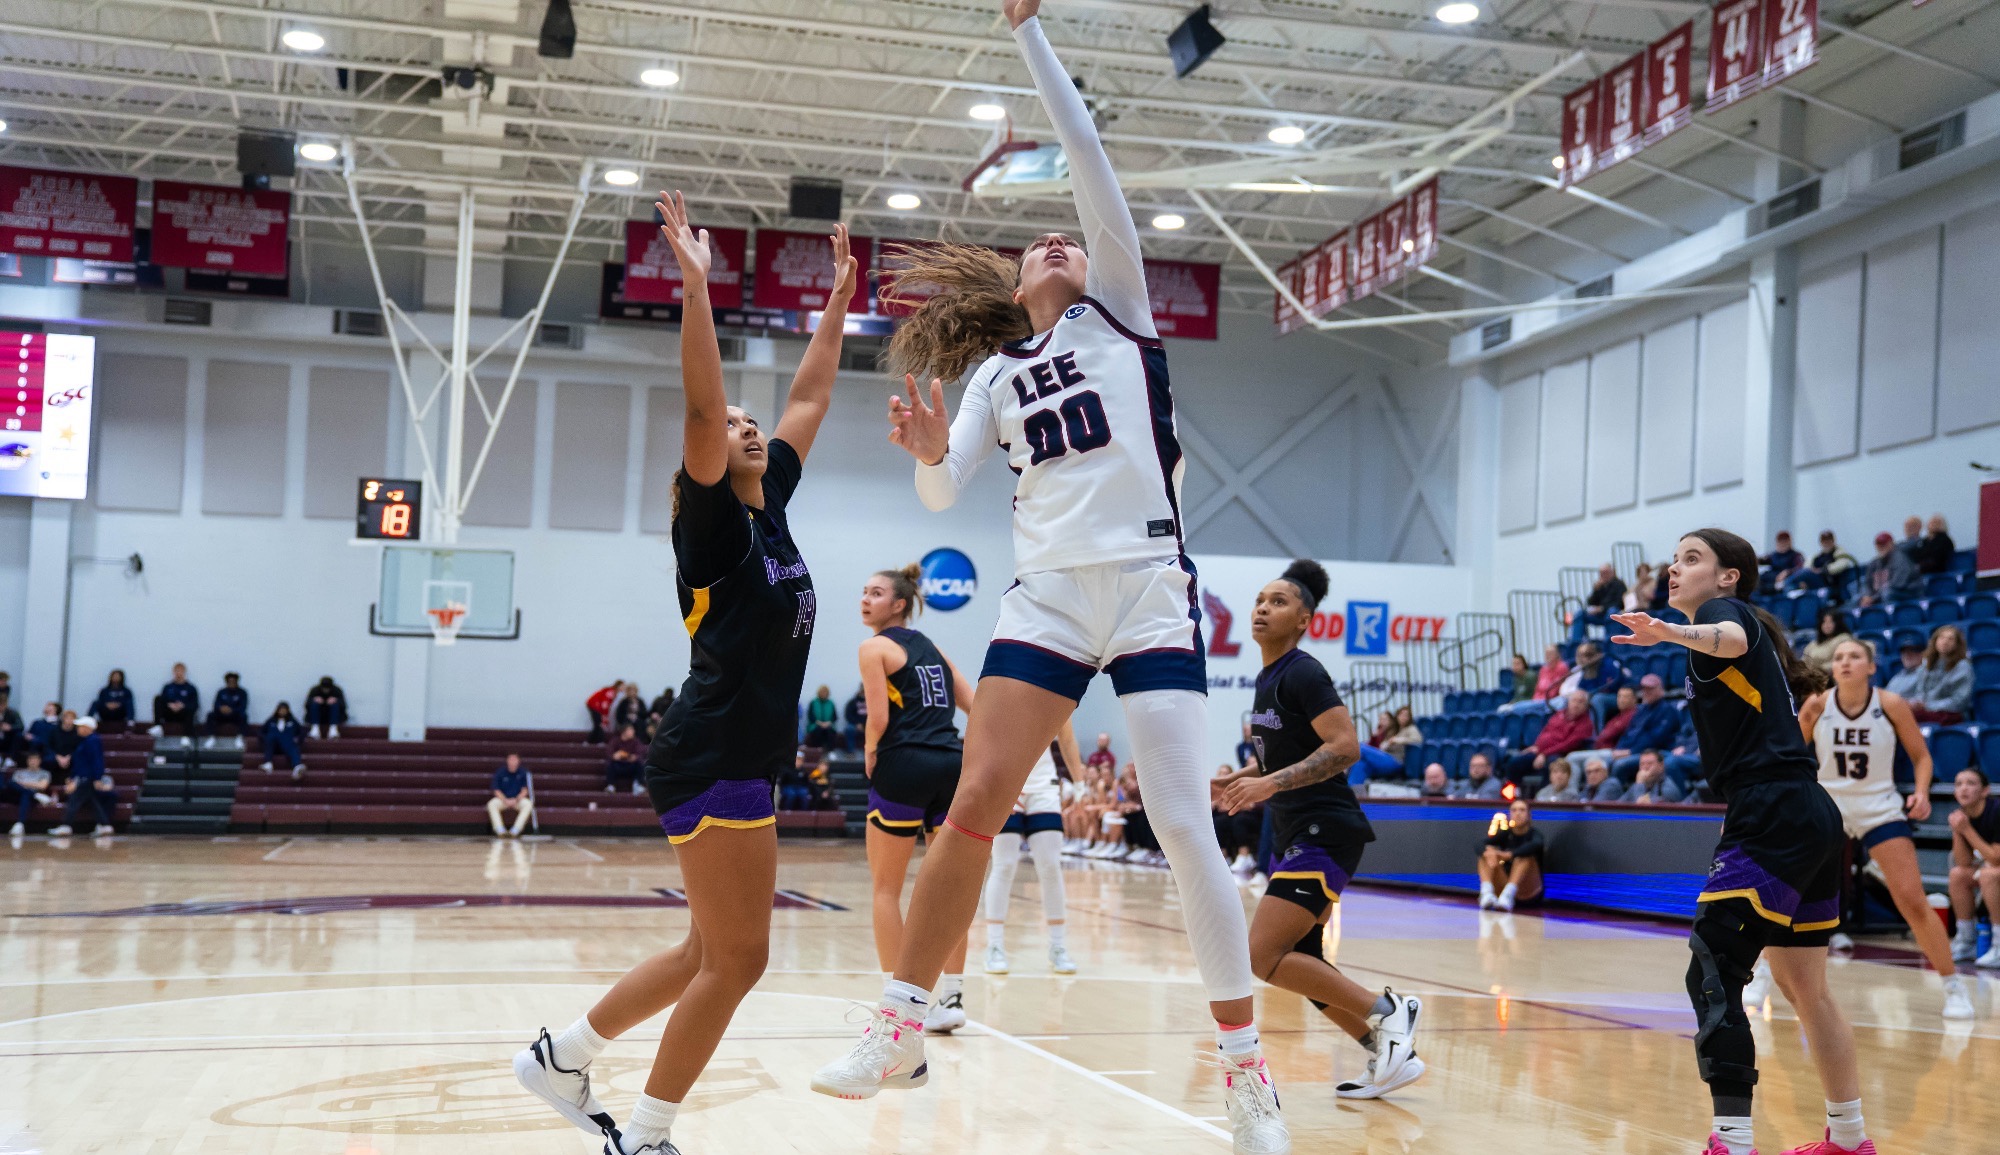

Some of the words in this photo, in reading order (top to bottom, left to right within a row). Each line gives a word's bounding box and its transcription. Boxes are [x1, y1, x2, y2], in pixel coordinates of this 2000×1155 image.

[1011, 350, 1086, 409] LEE
[1023, 389, 1113, 467] 00
[381, 504, 410, 536] 18
[921, 578, 976, 597] NCAA
[1390, 614, 1446, 641] CITY
[915, 664, 949, 708] 13
[1833, 728, 1870, 746] LEE
[1833, 751, 1869, 780] 13
